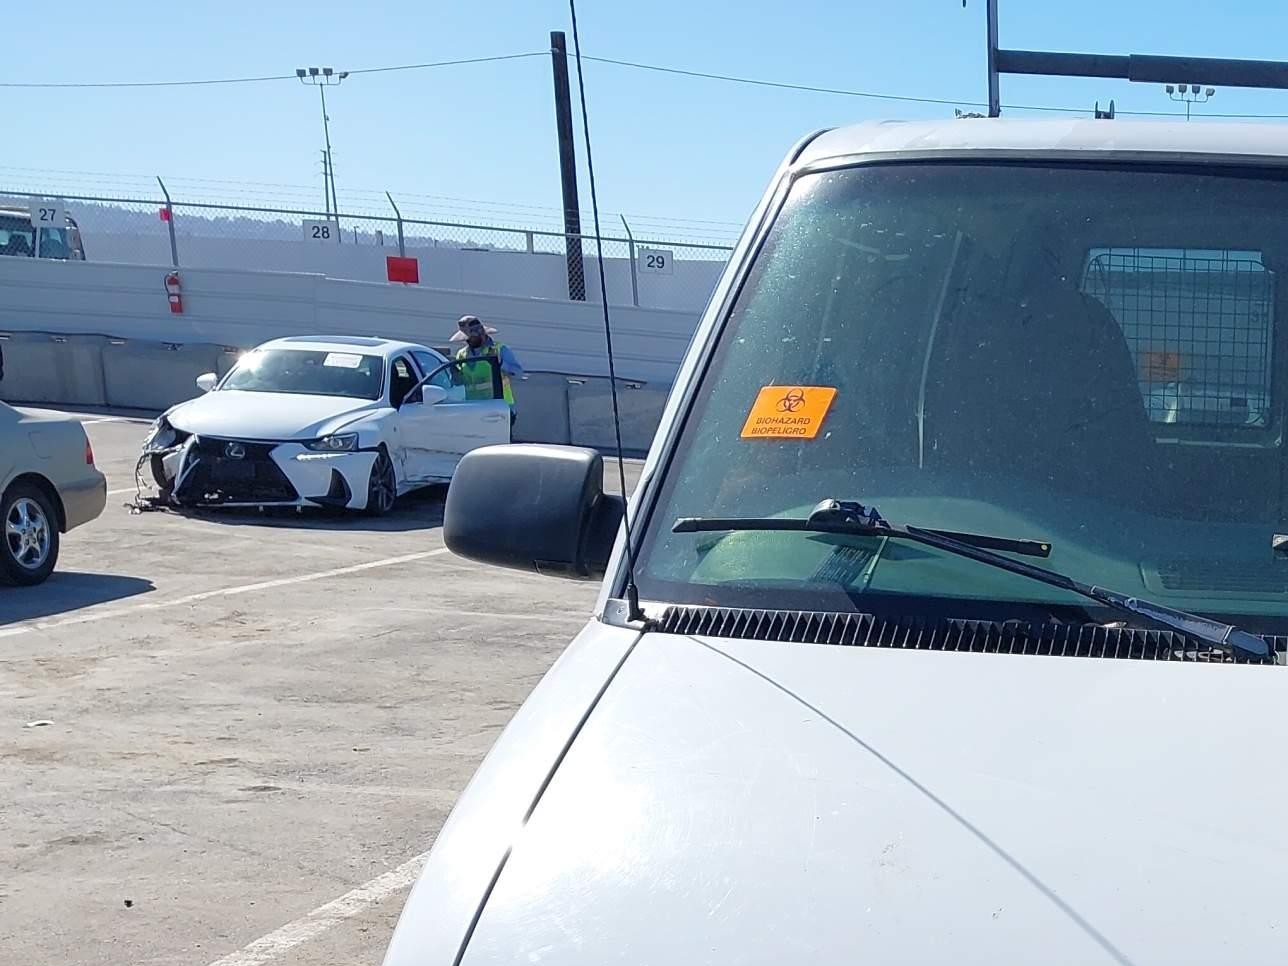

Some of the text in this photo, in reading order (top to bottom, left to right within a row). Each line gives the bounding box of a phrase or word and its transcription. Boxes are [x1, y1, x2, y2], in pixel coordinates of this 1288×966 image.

[39, 208, 57, 221] 27
[312, 225, 340, 239] 28
[647, 254, 665, 269] 29
[755, 417, 811, 425] BIOHAZARD
[751, 427, 807, 435] BIOPELIGRO
